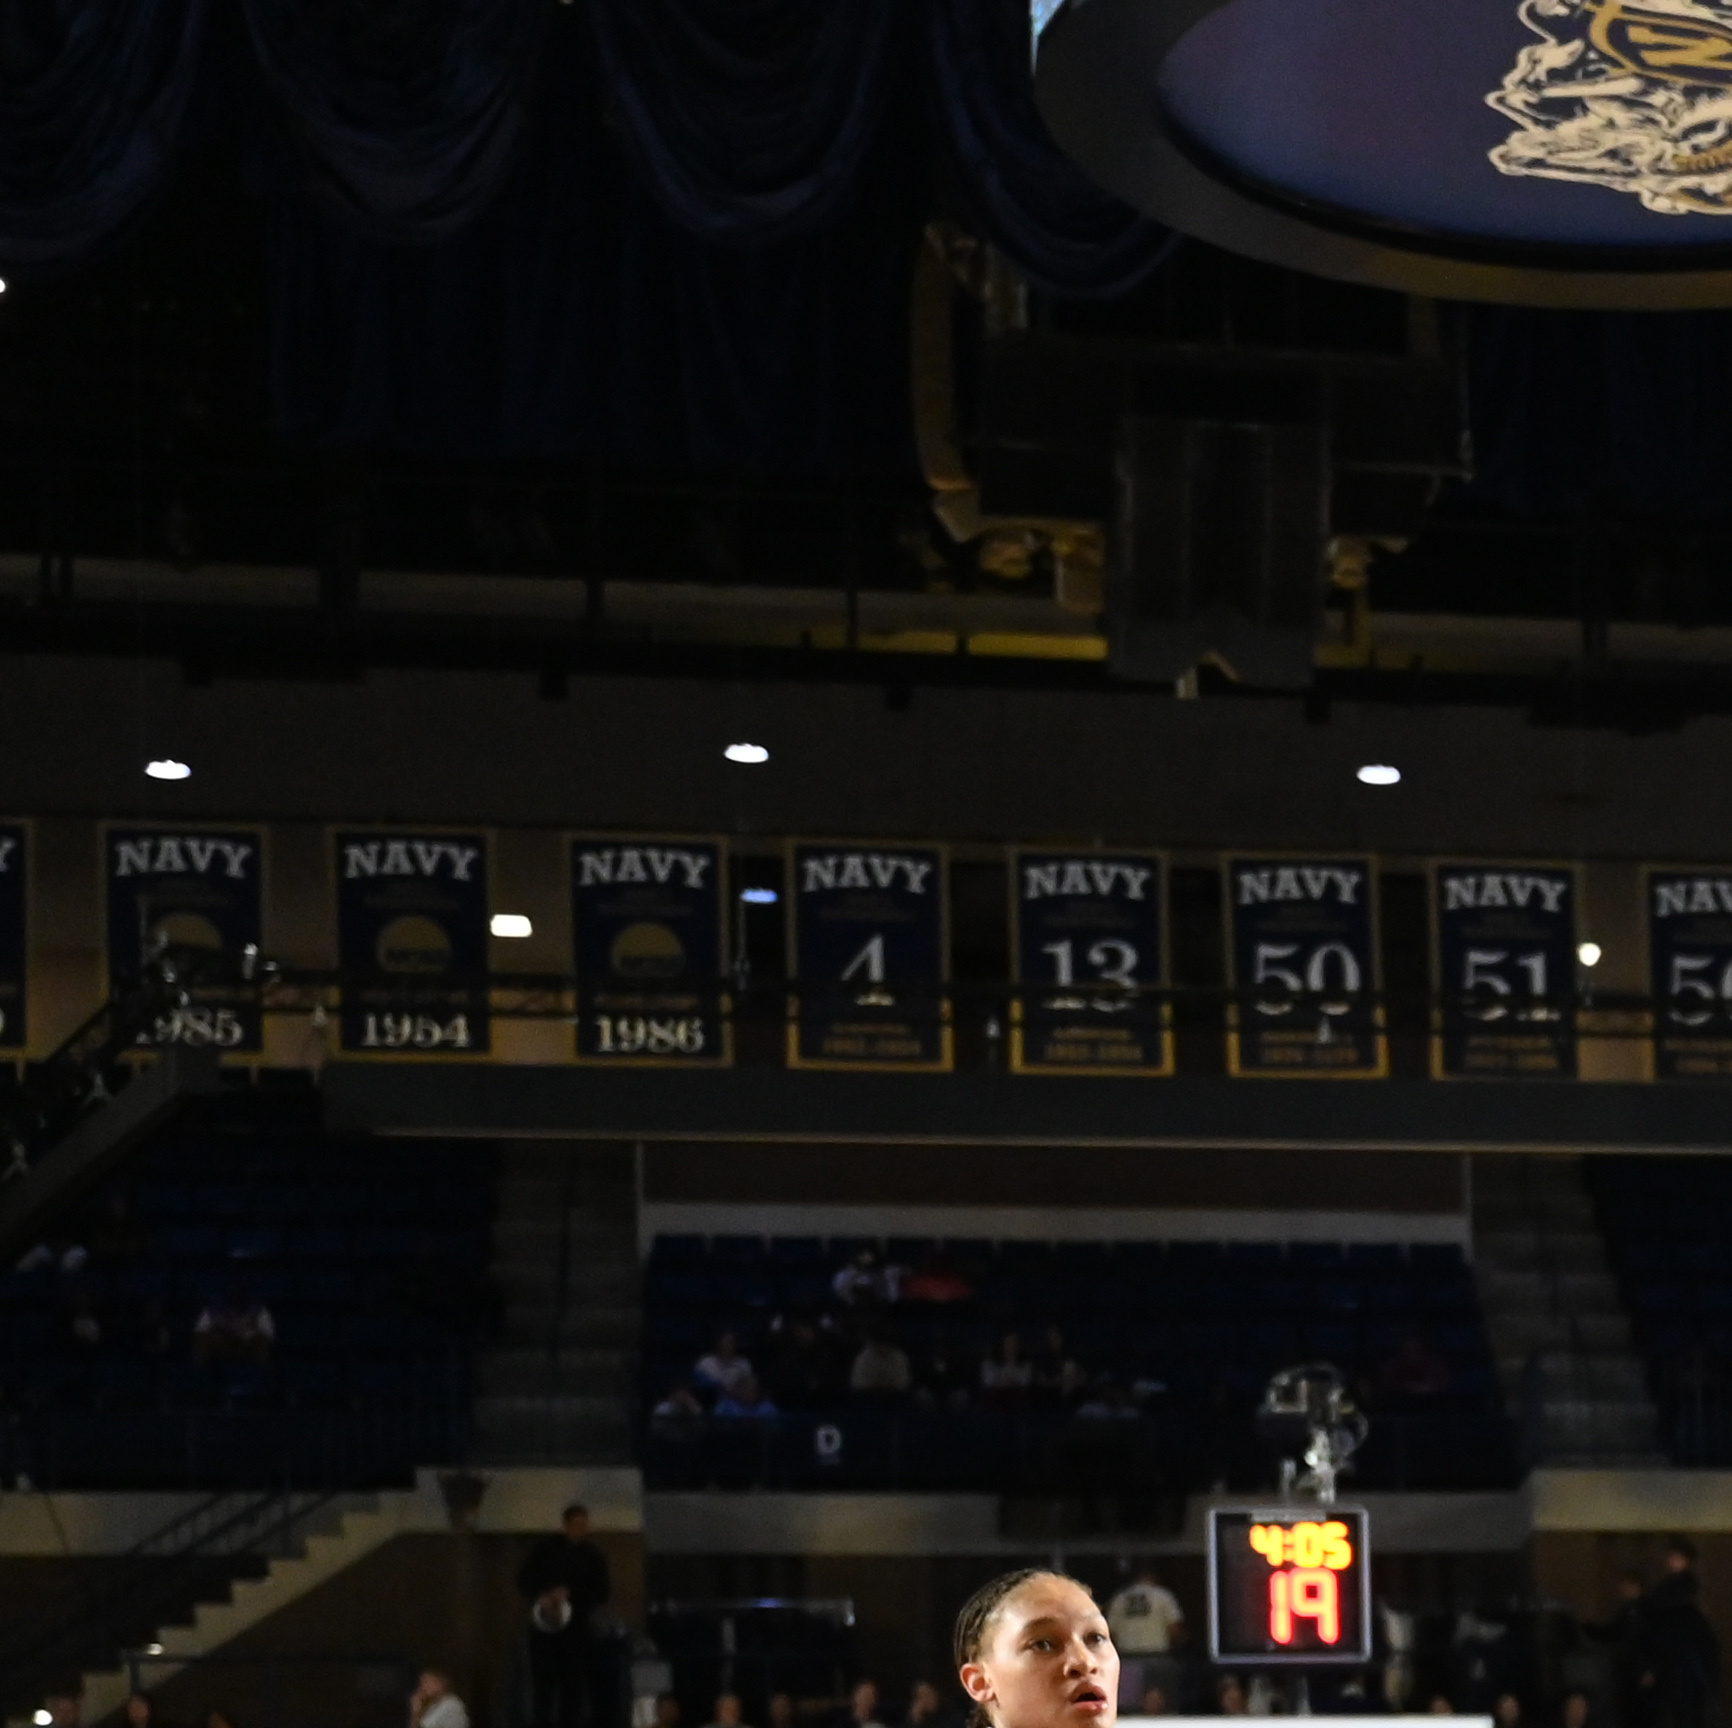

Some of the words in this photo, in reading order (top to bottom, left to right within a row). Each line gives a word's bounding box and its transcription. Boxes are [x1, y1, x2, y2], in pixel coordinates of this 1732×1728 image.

[114, 836, 252, 880] NAVY
[344, 842, 479, 882] NAVY
[578, 851, 710, 890] NAVY
[803, 855, 933, 894] NAVY
[1024, 862, 1151, 900] NAVY
[1238, 867, 1360, 905] NAVY
[1444, 875, 1567, 913] NAVY
[1041, 938, 1140, 1013] 13
[1253, 941, 1362, 1016] 50
[1462, 949, 1561, 1024] 51
[136, 1005, 244, 1047] 985
[361, 1013, 470, 1050] 1954
[595, 1016, 704, 1055] 1986
[1249, 1521, 1352, 1570] 4:05
[1270, 1566, 1340, 1645] 19
